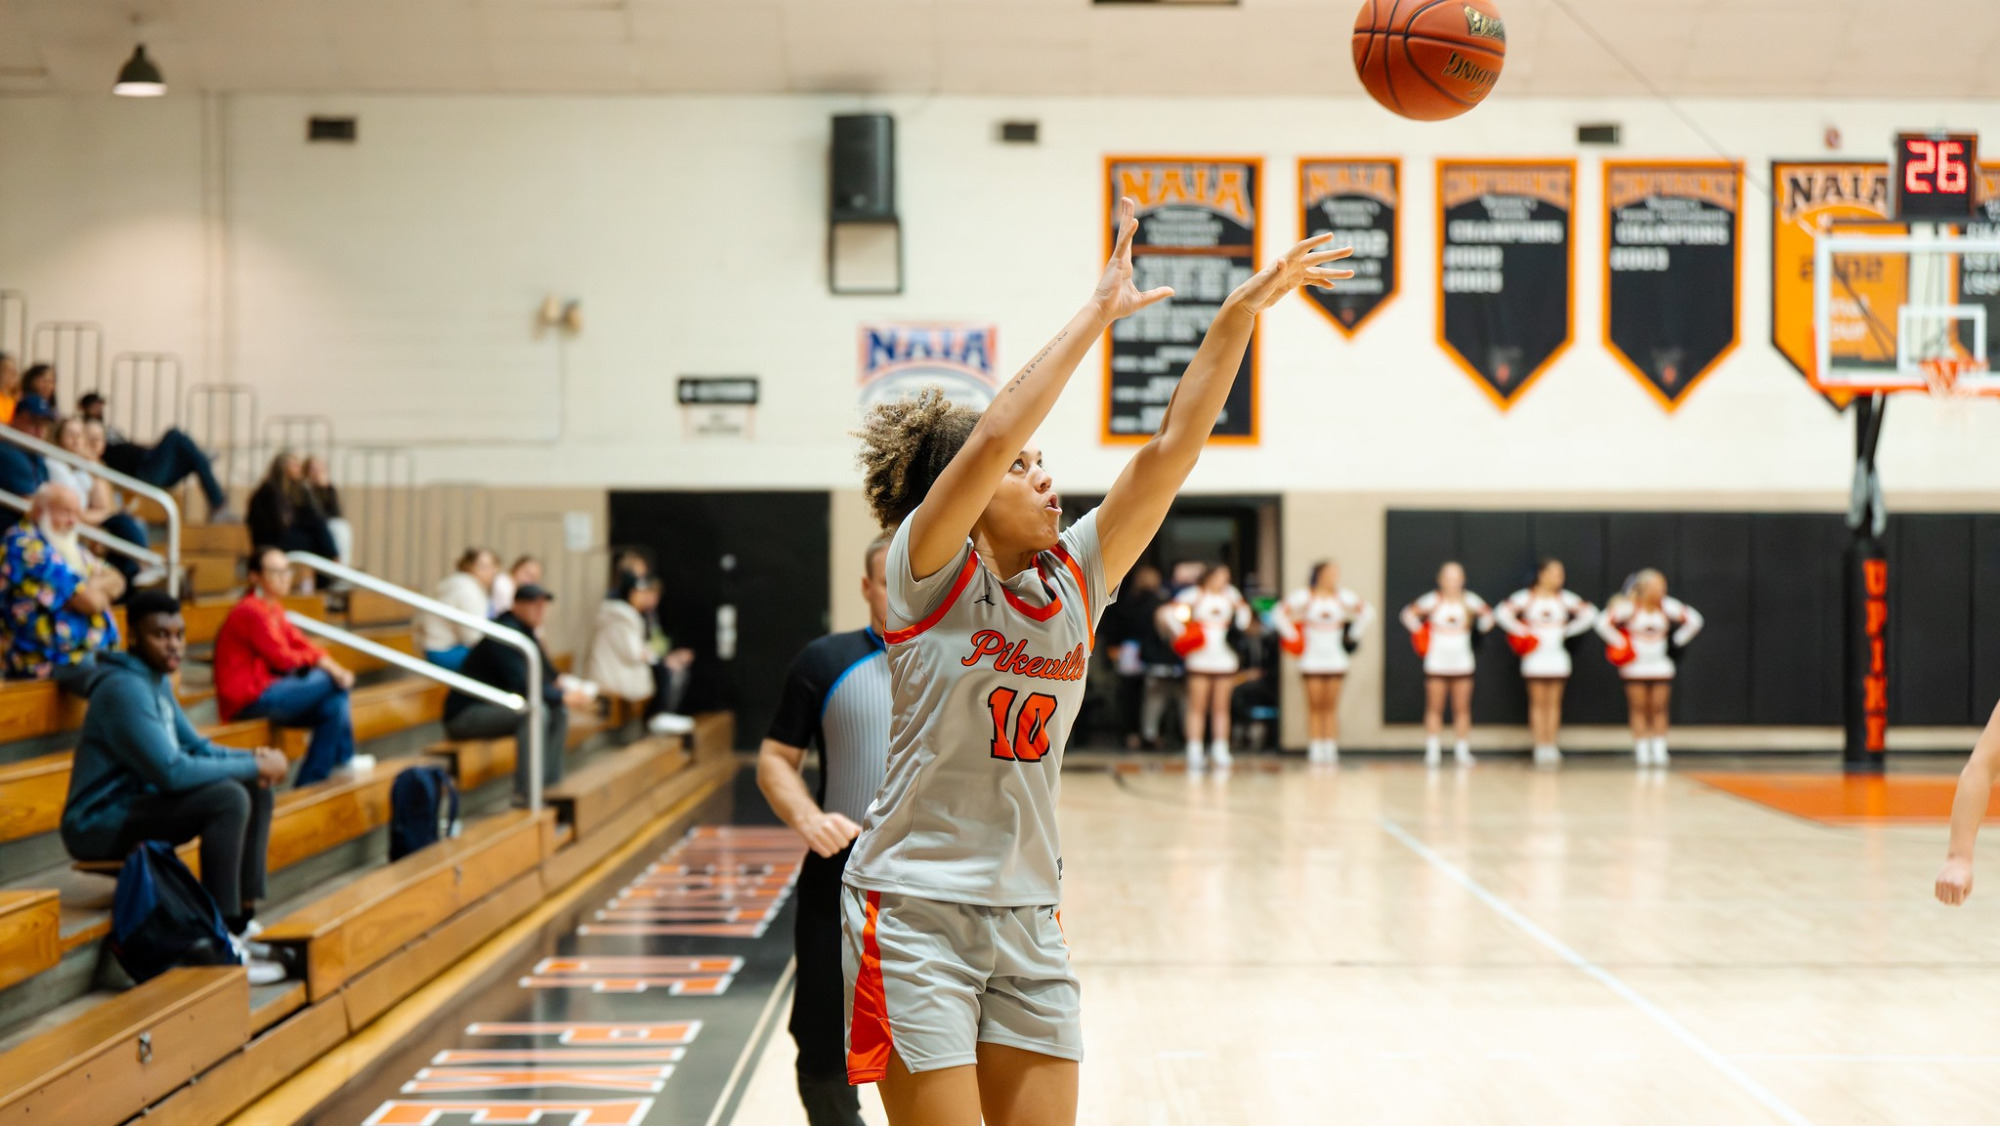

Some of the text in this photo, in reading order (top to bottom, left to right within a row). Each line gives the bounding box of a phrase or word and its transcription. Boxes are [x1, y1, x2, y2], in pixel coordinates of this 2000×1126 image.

[1905, 140, 1968, 194] 26
[1119, 168, 1251, 219] NAIA
[1786, 173, 1887, 217] NAIA
[1615, 223, 1730, 245] CHAMPIONS
[867, 326, 990, 372] NAIA
[988, 686, 1058, 763] 10
